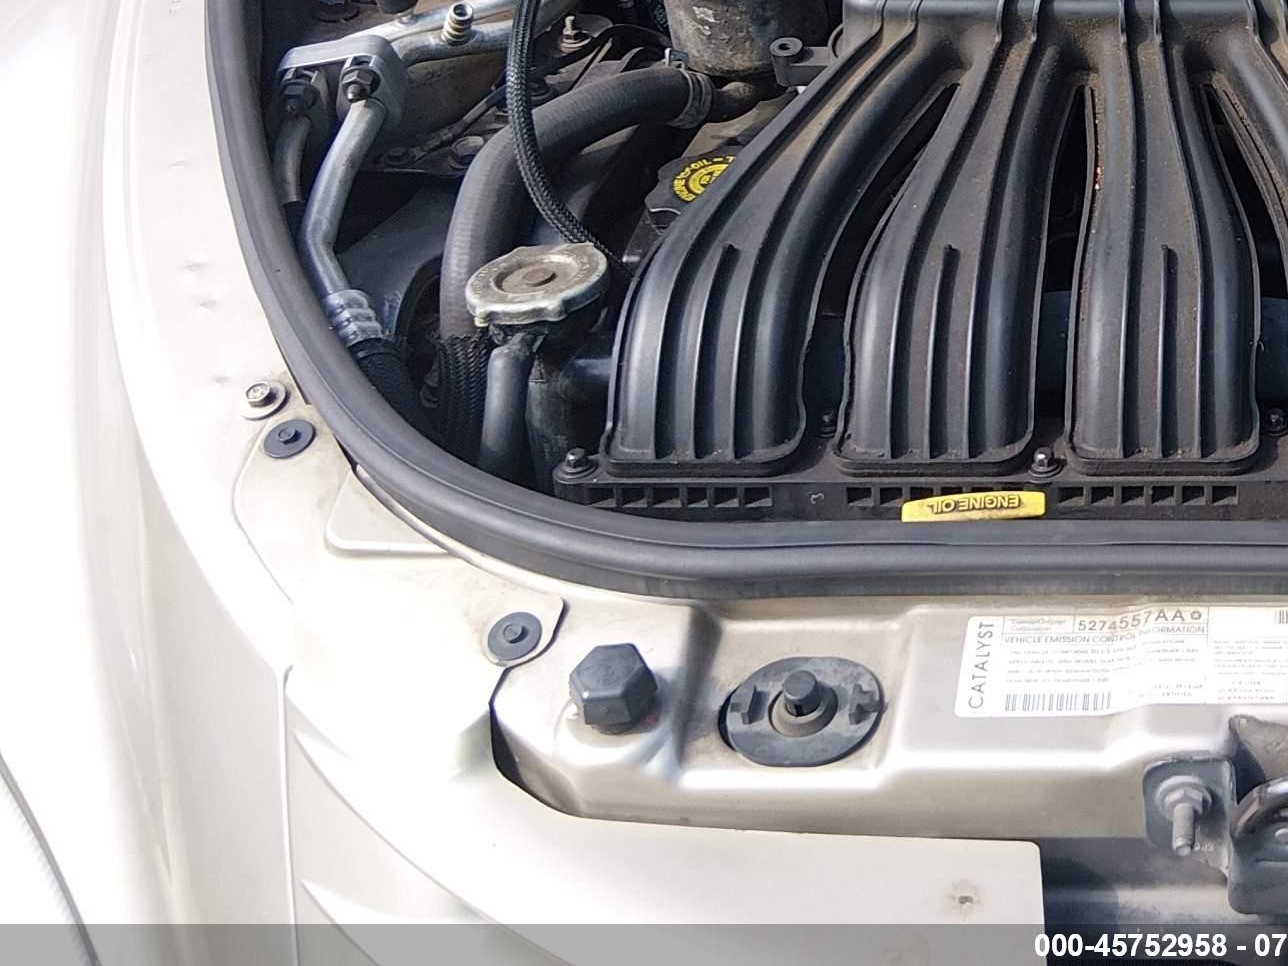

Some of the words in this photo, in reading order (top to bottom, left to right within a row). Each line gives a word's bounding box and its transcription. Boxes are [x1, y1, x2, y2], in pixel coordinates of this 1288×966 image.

[690, 159, 712, 169] OIL
[928, 501, 956, 514] OIL
[959, 495, 1020, 511] ENGINE
[1078, 609, 1184, 632] 5274557AA
[1004, 634, 1043, 644] VEHICLE
[1045, 633, 1090, 644] EMISSION
[1091, 631, 1136, 644] CONTROL
[968, 622, 995, 709] CATALYST
